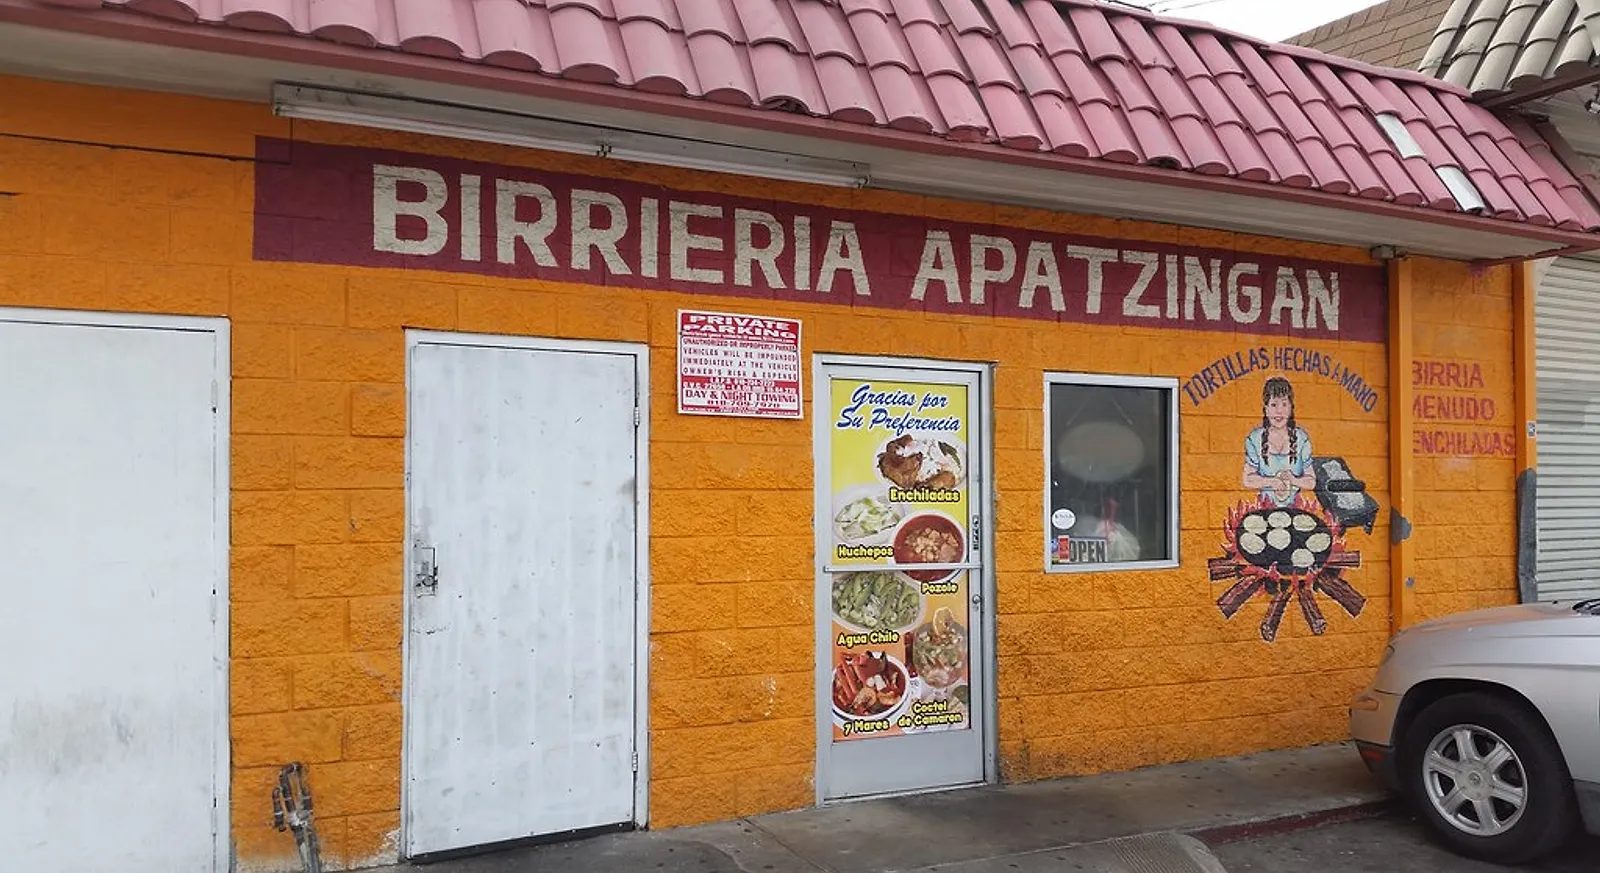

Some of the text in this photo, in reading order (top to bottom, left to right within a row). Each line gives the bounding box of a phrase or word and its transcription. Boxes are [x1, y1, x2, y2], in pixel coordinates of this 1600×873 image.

[371, 163, 1339, 331] BIRRIERIA APATZINGAN
[689, 315, 790, 331] PRIVATE
[682, 324, 797, 340] PARKING
[683, 338, 729, 348] UNAUTHORIZED
[683, 348, 719, 356] VEHICLES
[745, 351, 753, 359] BE
[758, 352, 796, 362] IMPOUNDED
[683, 357, 733, 367] IMMEDIATELY
[751, 361, 764, 369] THE
[768, 363, 797, 372] VEHICLE
[683, 367, 722, 376] OWNER'S
[728, 369, 746, 377] RISK
[763, 370, 797, 381] EXPENSE
[1182, 347, 1270, 407] TORTILLAS
[1272, 347, 1331, 377] HECHAS
[1339, 367, 1379, 413] MANO
[685, 390, 796, 403] DAY & NIGHT TOWING
[851, 384, 948, 412] Gracias por
[836, 406, 960, 436] Su Preferencia
[889, 487, 961, 503] Enchiladas
[838, 544, 894, 560] Huchepos
[1069, 540, 1106, 562] OPEN
[920, 581, 959, 595] Pozole
[837, 629, 900, 649] Agua Chile
[912, 699, 948, 713] Coctel
[843, 719, 890, 736] 7 Mares
[897, 712, 963, 728] de Camaron
